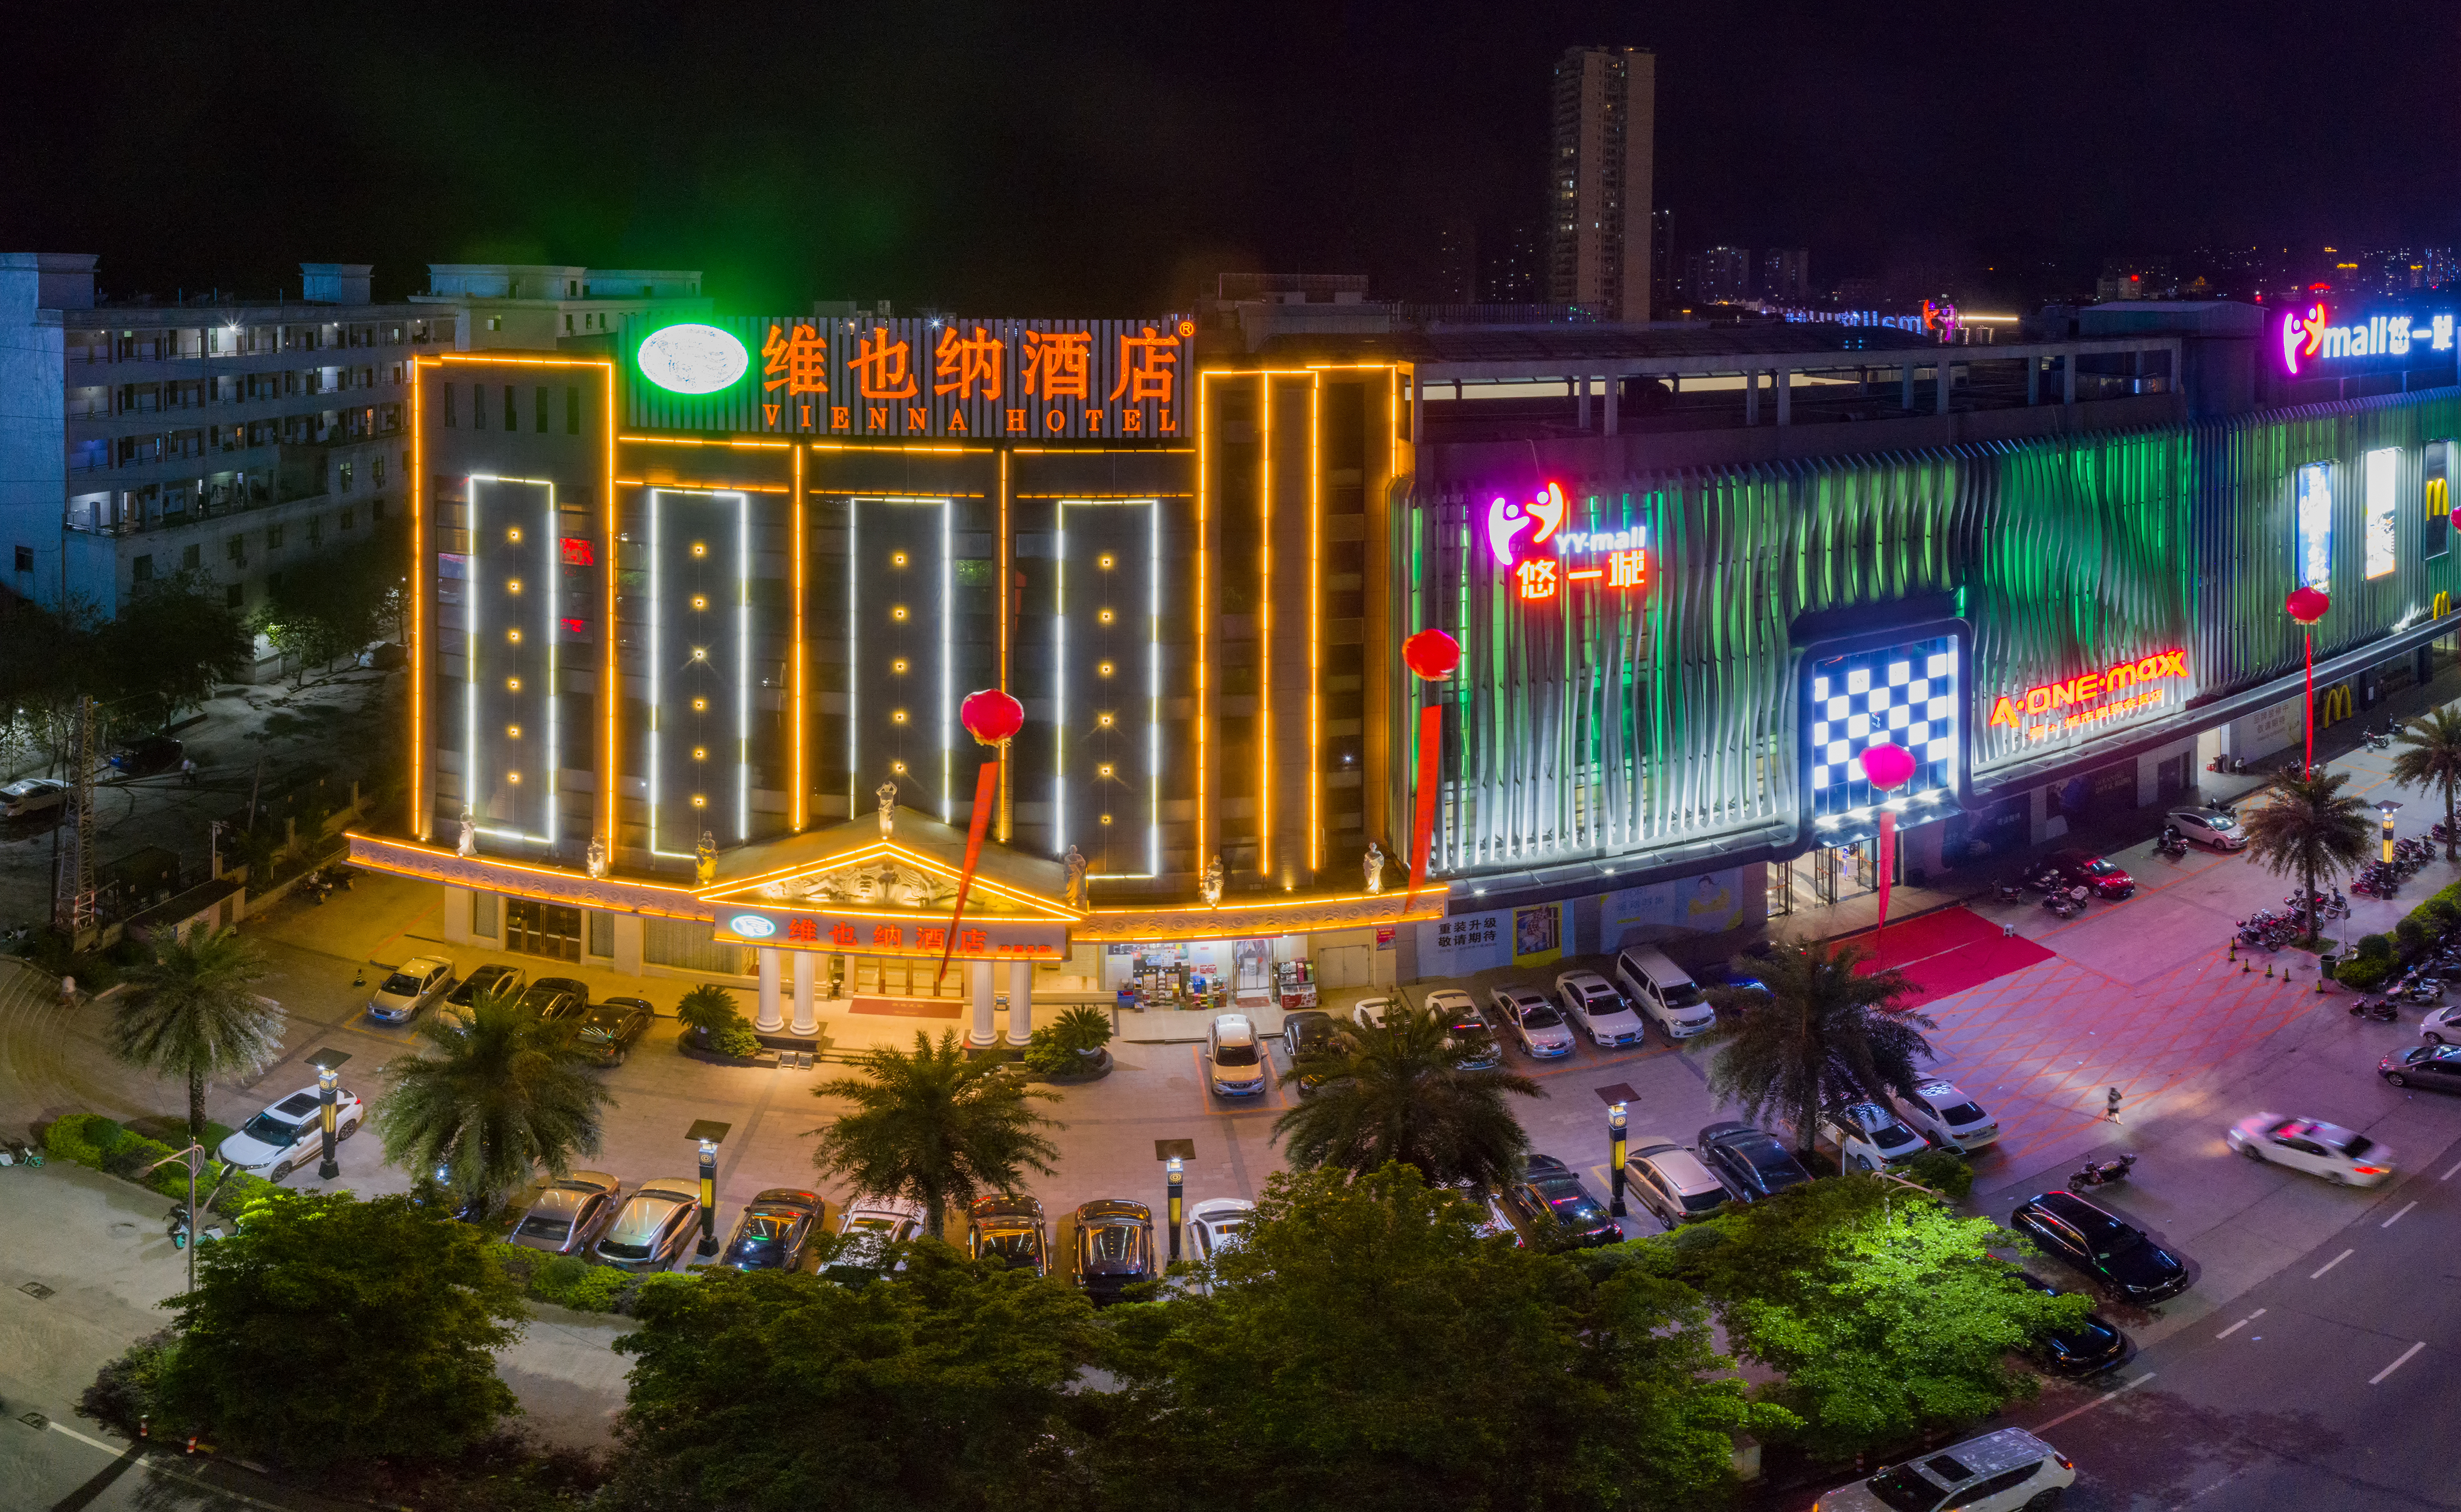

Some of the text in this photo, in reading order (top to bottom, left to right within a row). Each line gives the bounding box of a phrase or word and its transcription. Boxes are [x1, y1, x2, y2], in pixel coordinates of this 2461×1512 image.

[762, 324, 1180, 403] 维也纳酒店
[763, 404, 1176, 431] VIENNA HOTEL
[1516, 550, 1645, 598] 悠一城
[788, 918, 987, 954] 维也纳酒店
[1438, 918, 1497, 935] 重装升级
[1438, 930, 1497, 947] 敬请期待
